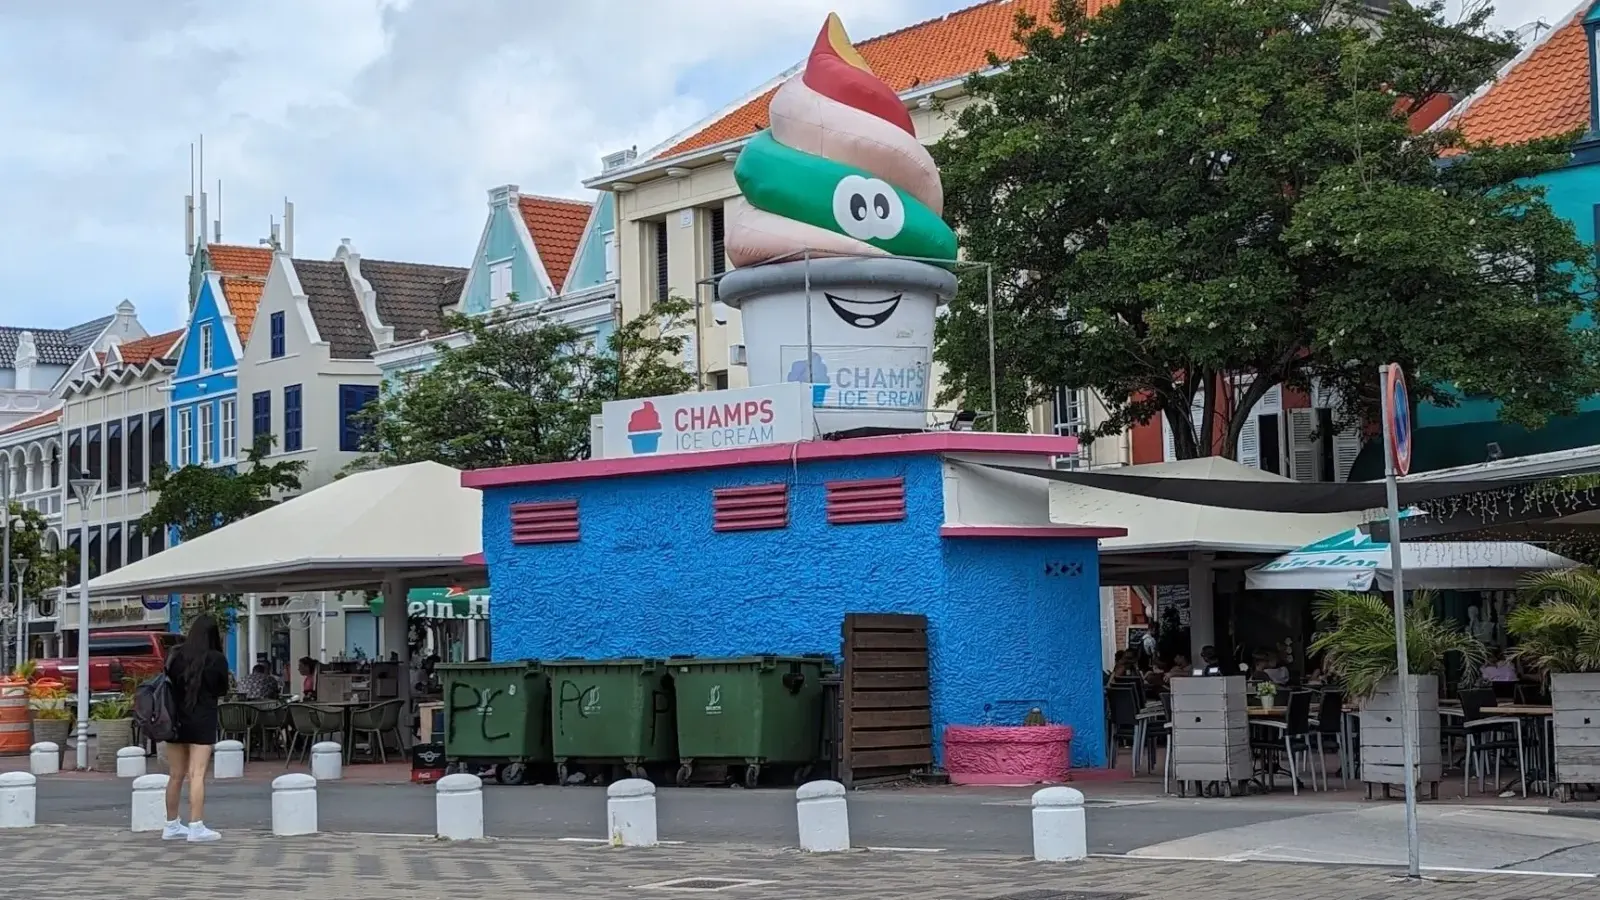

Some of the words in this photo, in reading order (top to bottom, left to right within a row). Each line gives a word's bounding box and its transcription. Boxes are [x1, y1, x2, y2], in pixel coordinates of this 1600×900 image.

[836, 367, 924, 389] CHAMPS
[838, 391, 868, 406] ICE
[876, 391, 923, 406] CREAM
[674, 399, 774, 432] CHAMPS
[676, 431, 703, 451] ICE
[711, 425, 774, 448] CREAM
